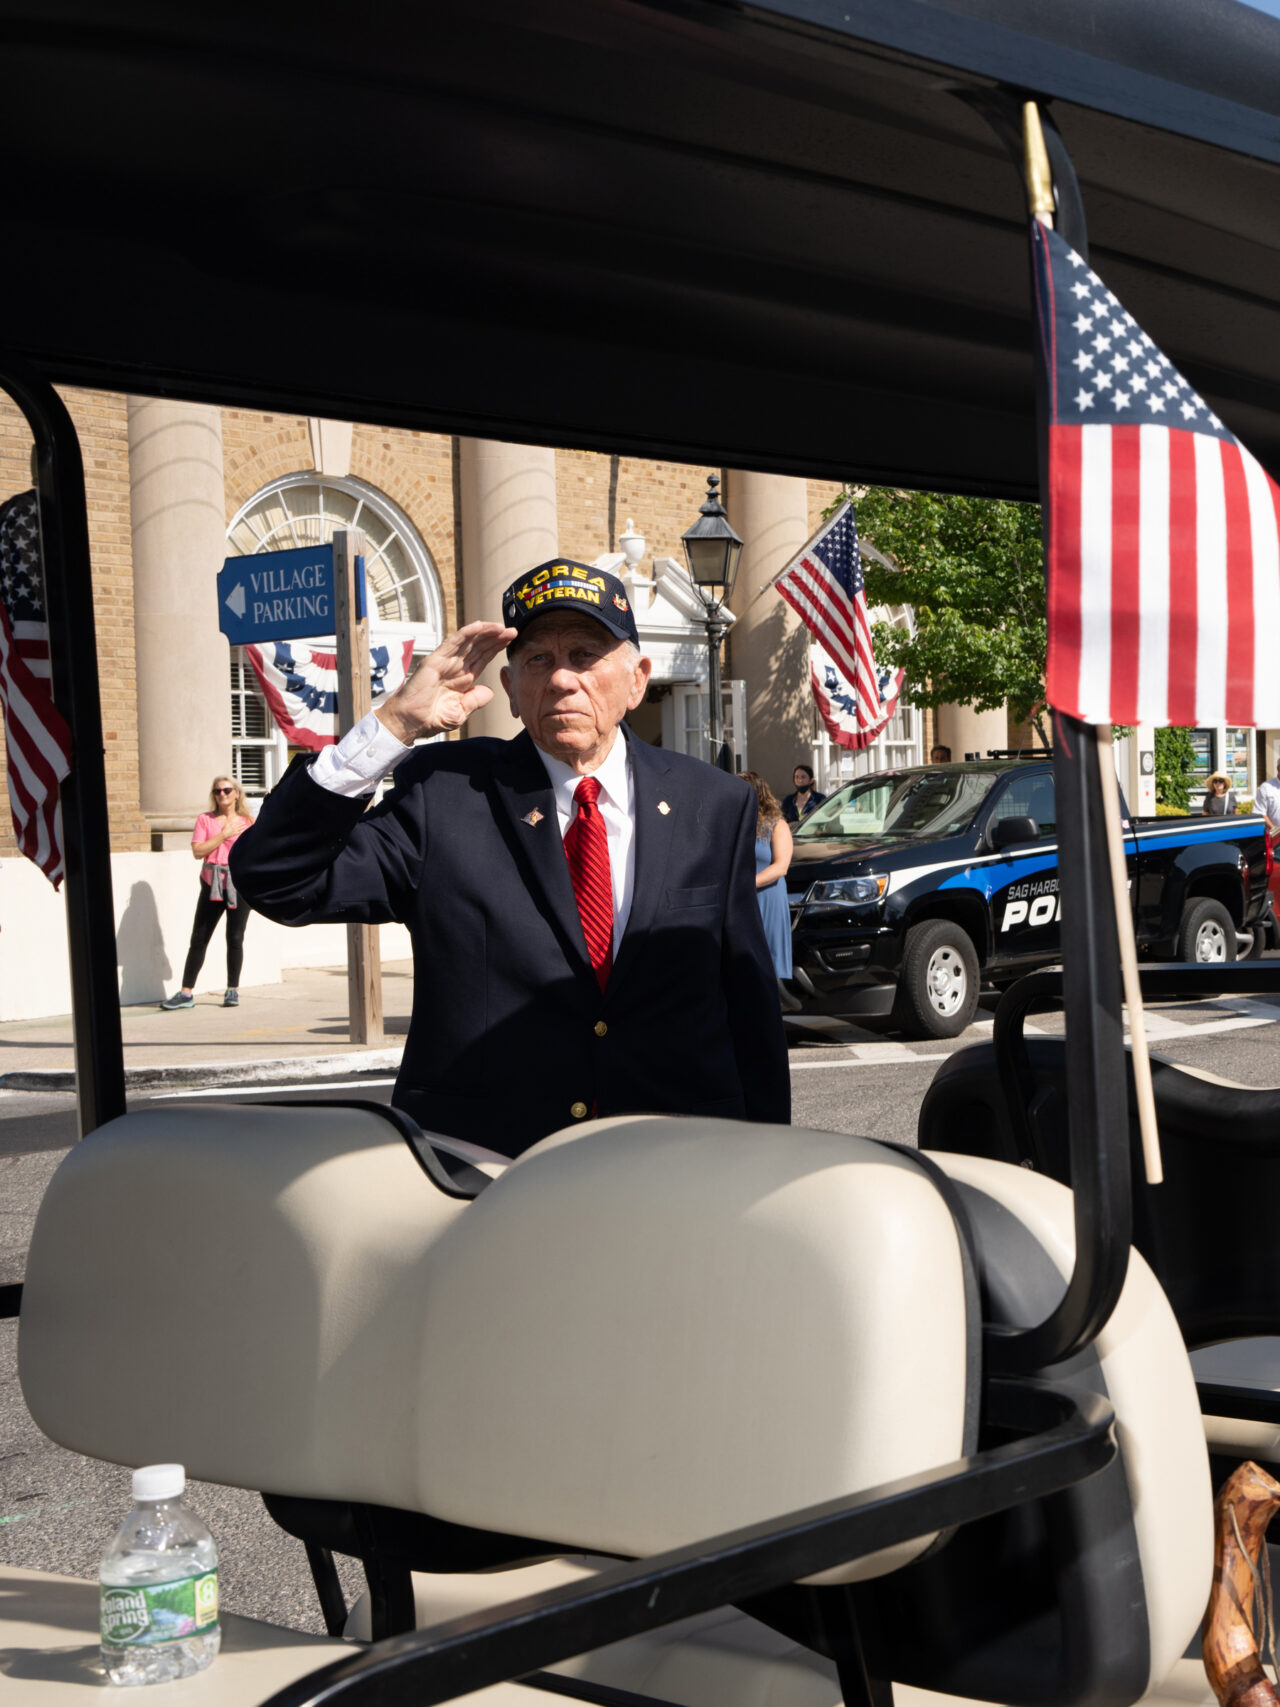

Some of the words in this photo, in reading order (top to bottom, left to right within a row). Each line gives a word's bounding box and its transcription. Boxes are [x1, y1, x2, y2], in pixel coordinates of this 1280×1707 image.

[250, 564, 326, 594] VILLAGE
[515, 564, 606, 600] KOREA
[253, 594, 329, 624] PARKING
[525, 586, 600, 610] VETERAN
[1007, 884, 1029, 900] SAG
